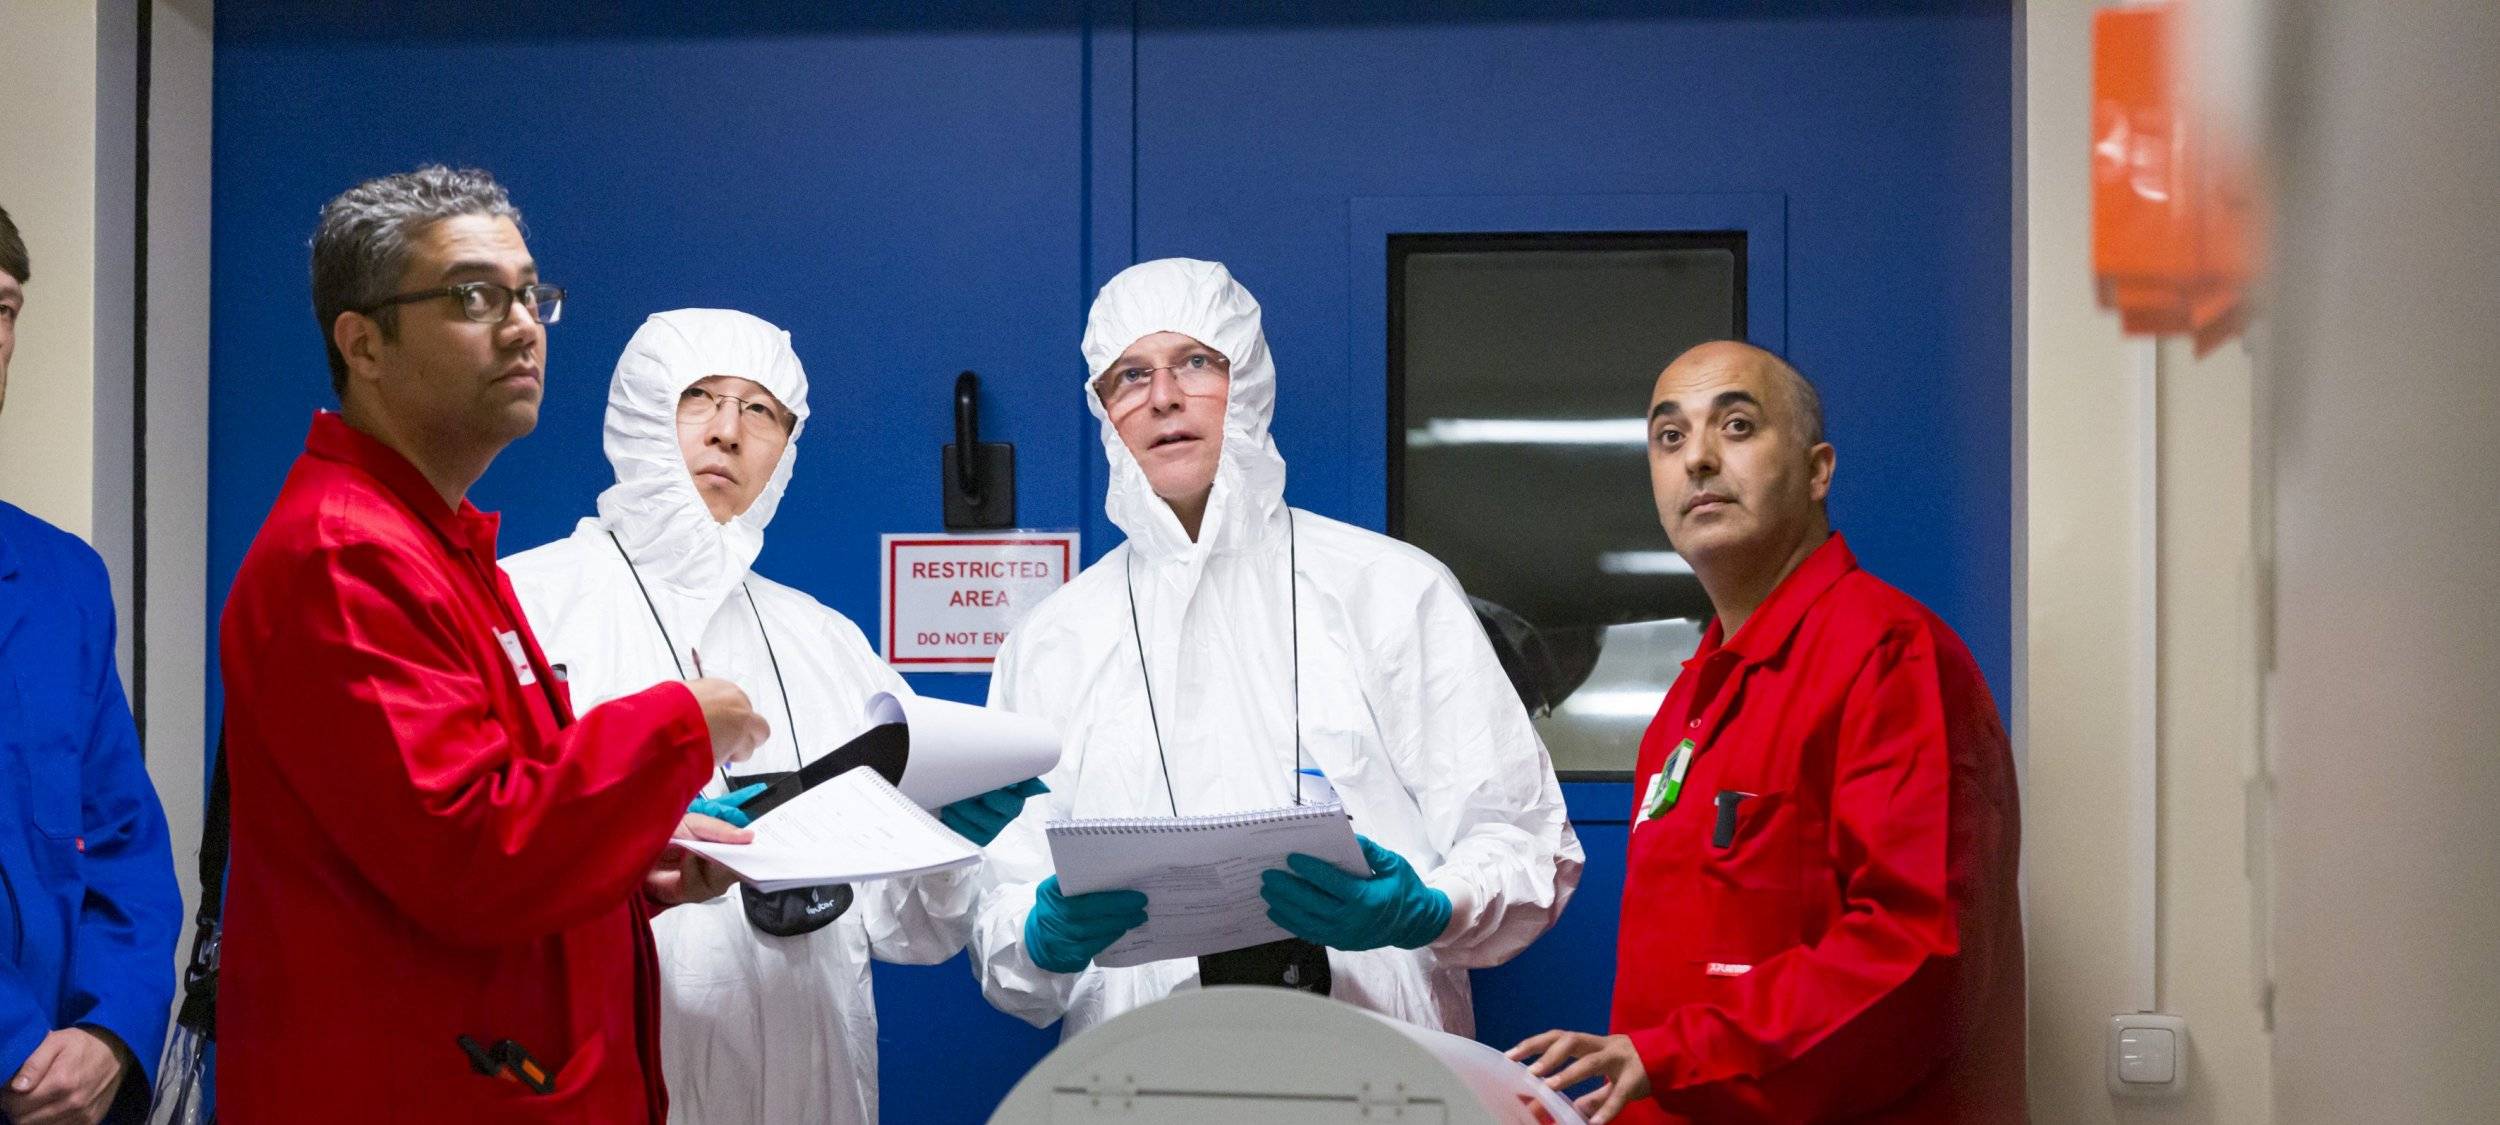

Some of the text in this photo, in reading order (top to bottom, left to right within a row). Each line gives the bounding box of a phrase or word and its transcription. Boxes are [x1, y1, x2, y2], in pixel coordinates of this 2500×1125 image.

[912, 562, 1048, 578] RESTRICTED
[949, 590, 1010, 607] AREA
[917, 632, 1009, 645] DO NOT EN
